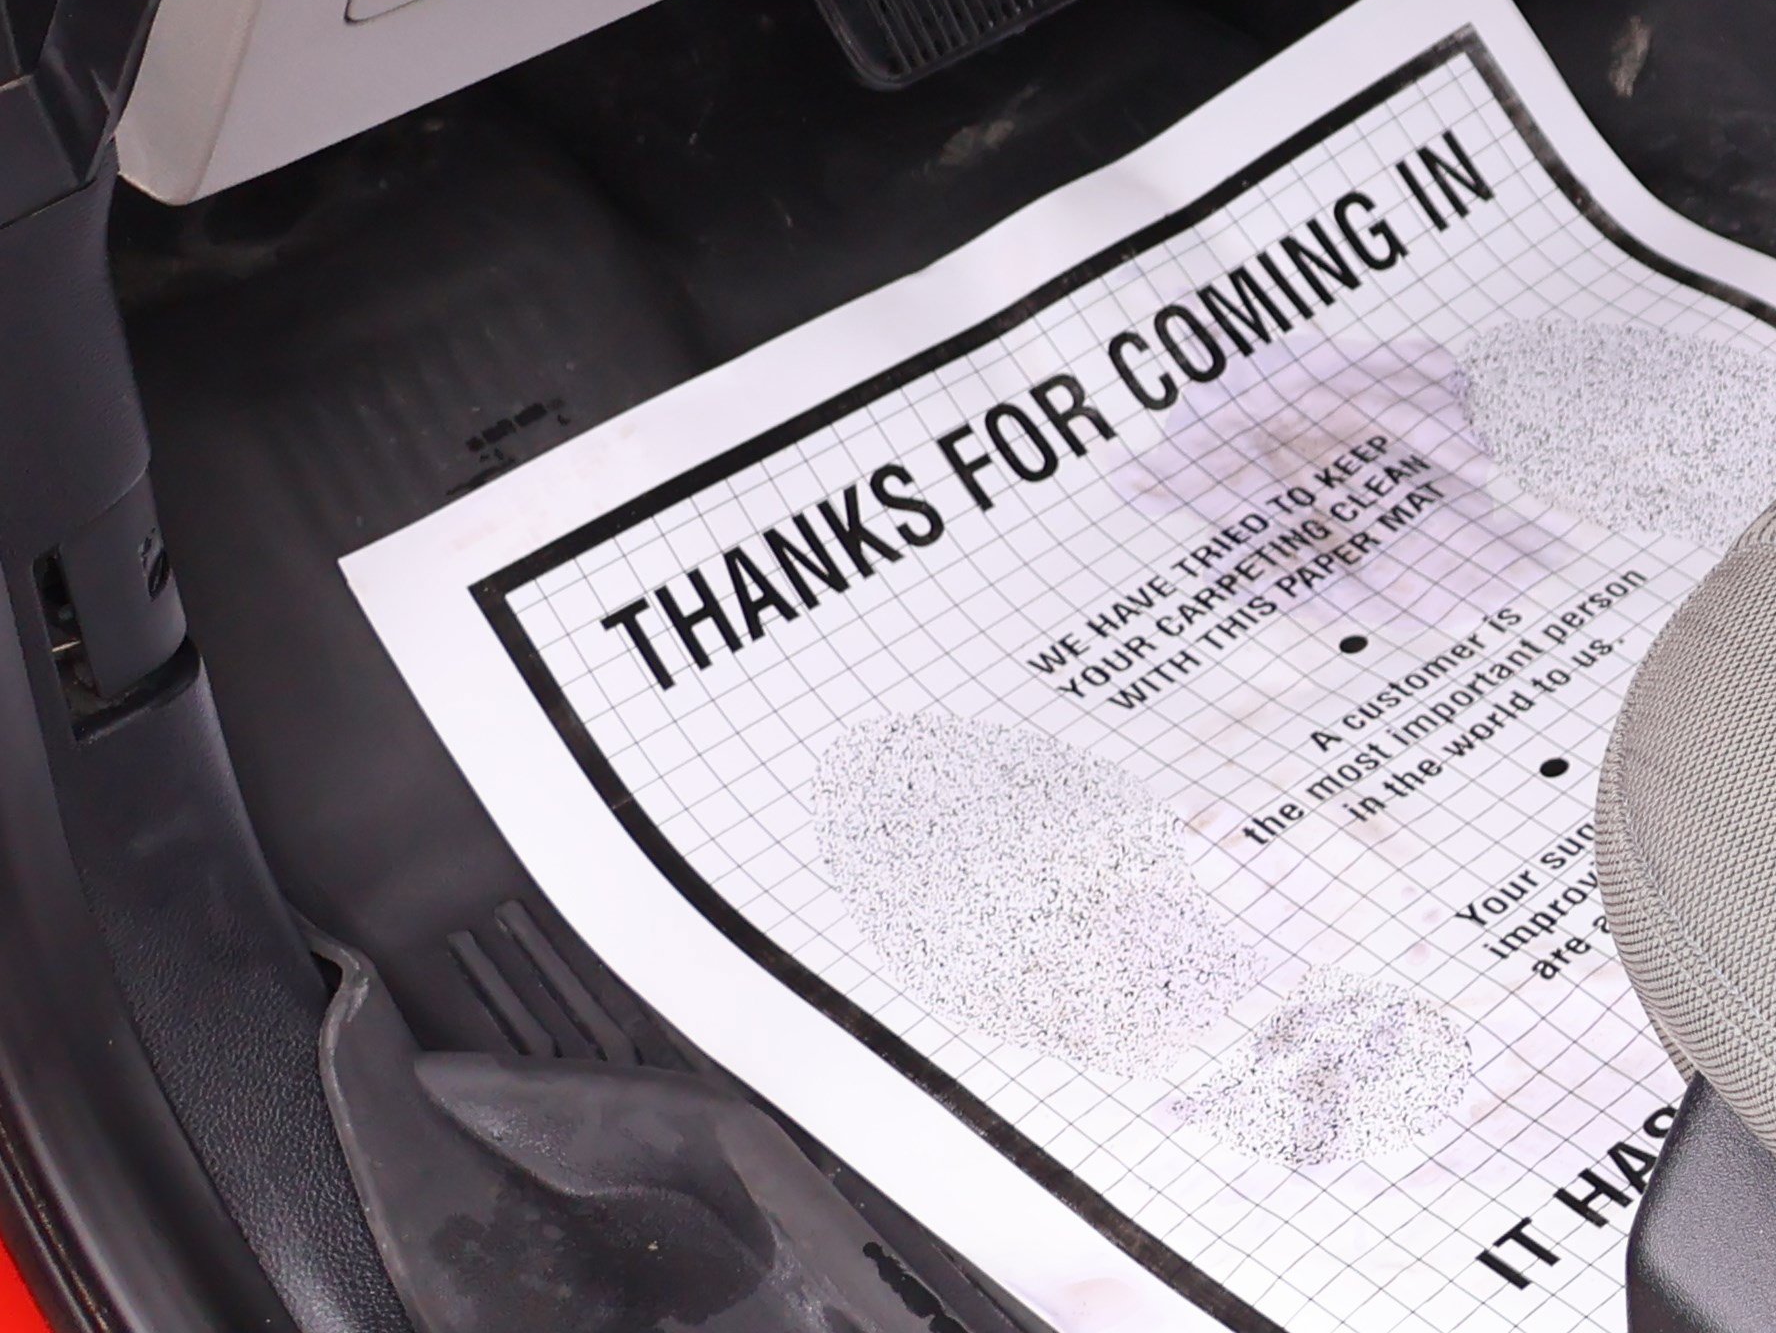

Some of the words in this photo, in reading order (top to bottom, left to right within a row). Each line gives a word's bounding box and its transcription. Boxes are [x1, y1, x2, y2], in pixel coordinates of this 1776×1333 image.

[600, 464, 945, 690] THANKS
[937, 374, 1117, 512] FOR
[1108, 192, 1409, 410] COMING
[1396, 130, 1495, 232] IN
[1027, 633, 1091, 676] WE
[1087, 575, 1176, 638] HAVE
[1172, 512, 1270, 578] TRIED
[1266, 486, 1316, 515] TO
[1315, 435, 1390, 489] KEEP
[1057, 634, 1157, 701] YOUR
[1156, 518, 1330, 637] CARPETING
[1331, 453, 1431, 523] CLEAN
[1108, 649, 1202, 712] WITH
[1199, 595, 1278, 650] THIS
[1275, 532, 1381, 598] PAPER
[1377, 480, 1446, 532] MAT
[1242, 800, 1305, 846] the
[1306, 741, 1392, 801] most
[1389, 640, 1543, 746] important
[1543, 568, 1648, 646] person
[1310, 730, 1342, 752] A
[1343, 633, 1486, 731] customer
[1483, 607, 1523, 635] is
[1342, 796, 1386, 822] in
[1383, 758, 1443, 799] the
[1442, 691, 1535, 758] world
[1532, 667, 1572, 695] to
[1572, 636, 1625, 669] us.
[1455, 869, 1539, 928] Your
[1483, 861, 1598, 960] improv
[1532, 936, 1591, 981] are
[1475, 1217, 1561, 1290] IT
